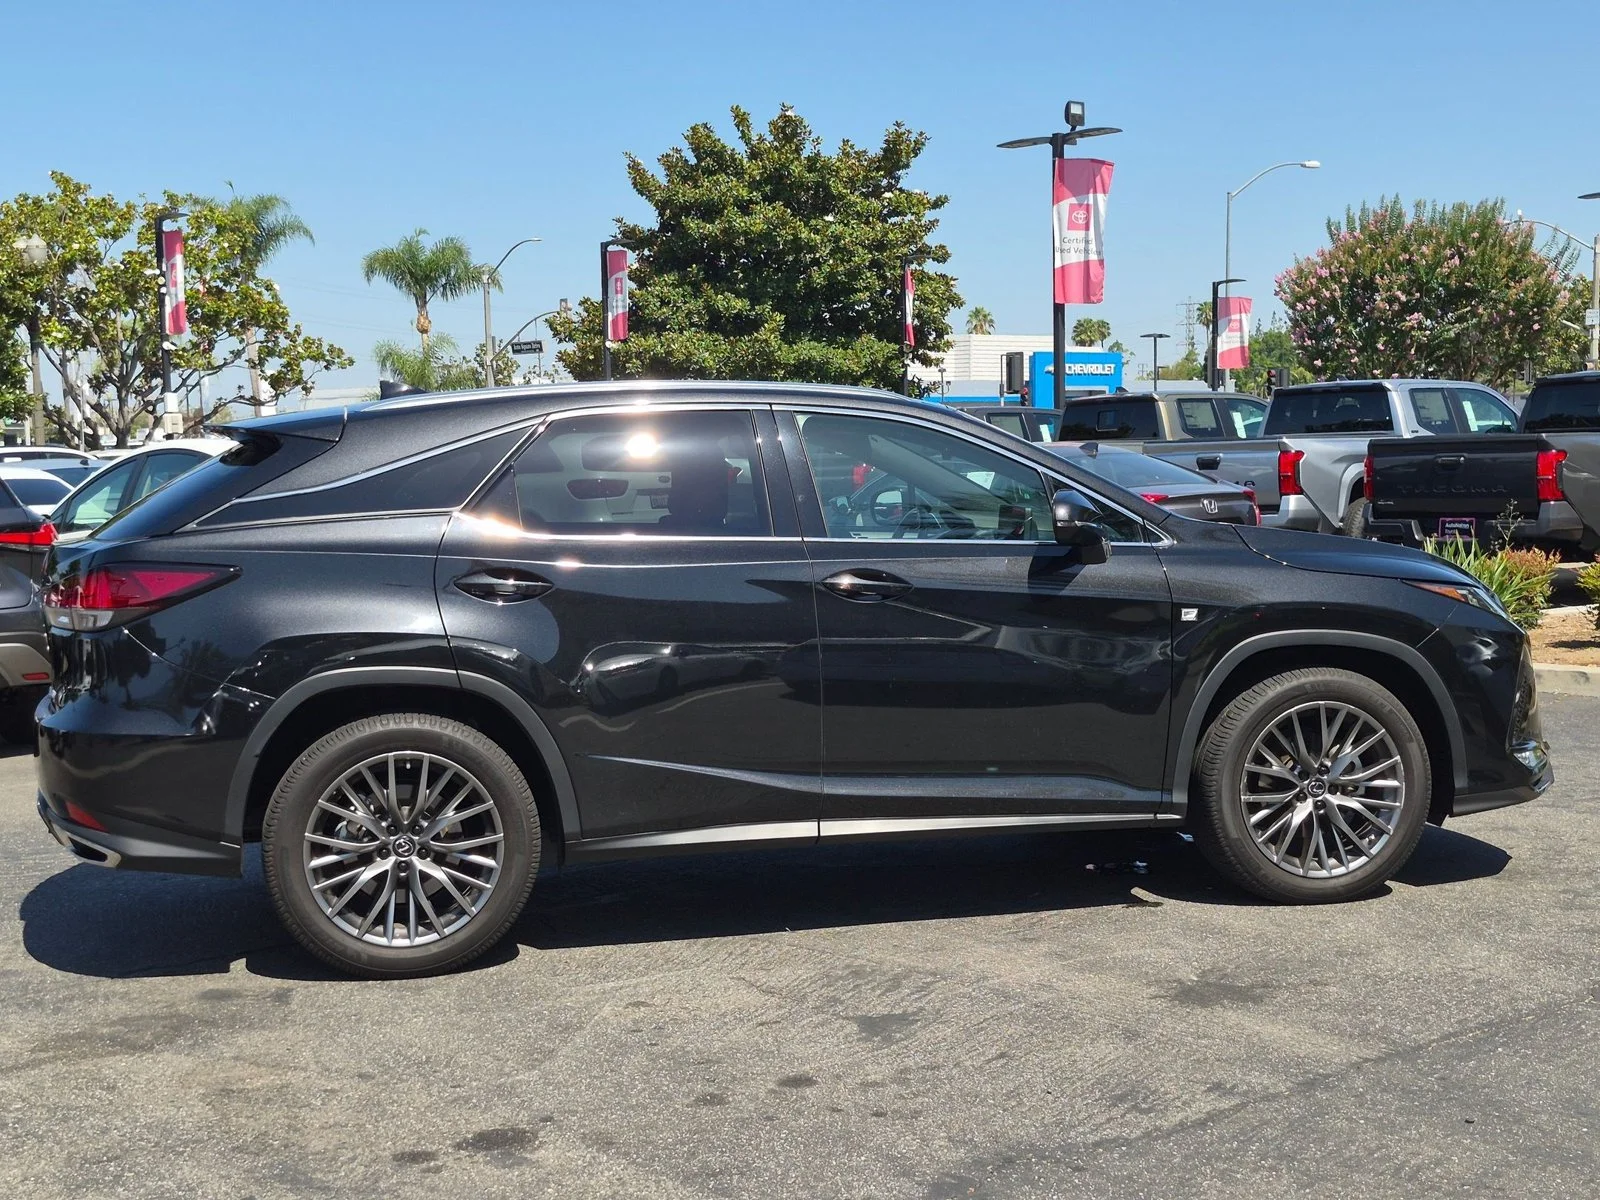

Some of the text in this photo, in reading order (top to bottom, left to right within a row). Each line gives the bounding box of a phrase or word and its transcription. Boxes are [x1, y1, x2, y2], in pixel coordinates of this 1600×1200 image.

[1055, 246, 1071, 254] Used
[1065, 363, 1115, 375] CHEVROLET
[1397, 484, 1508, 493] TACOMA
